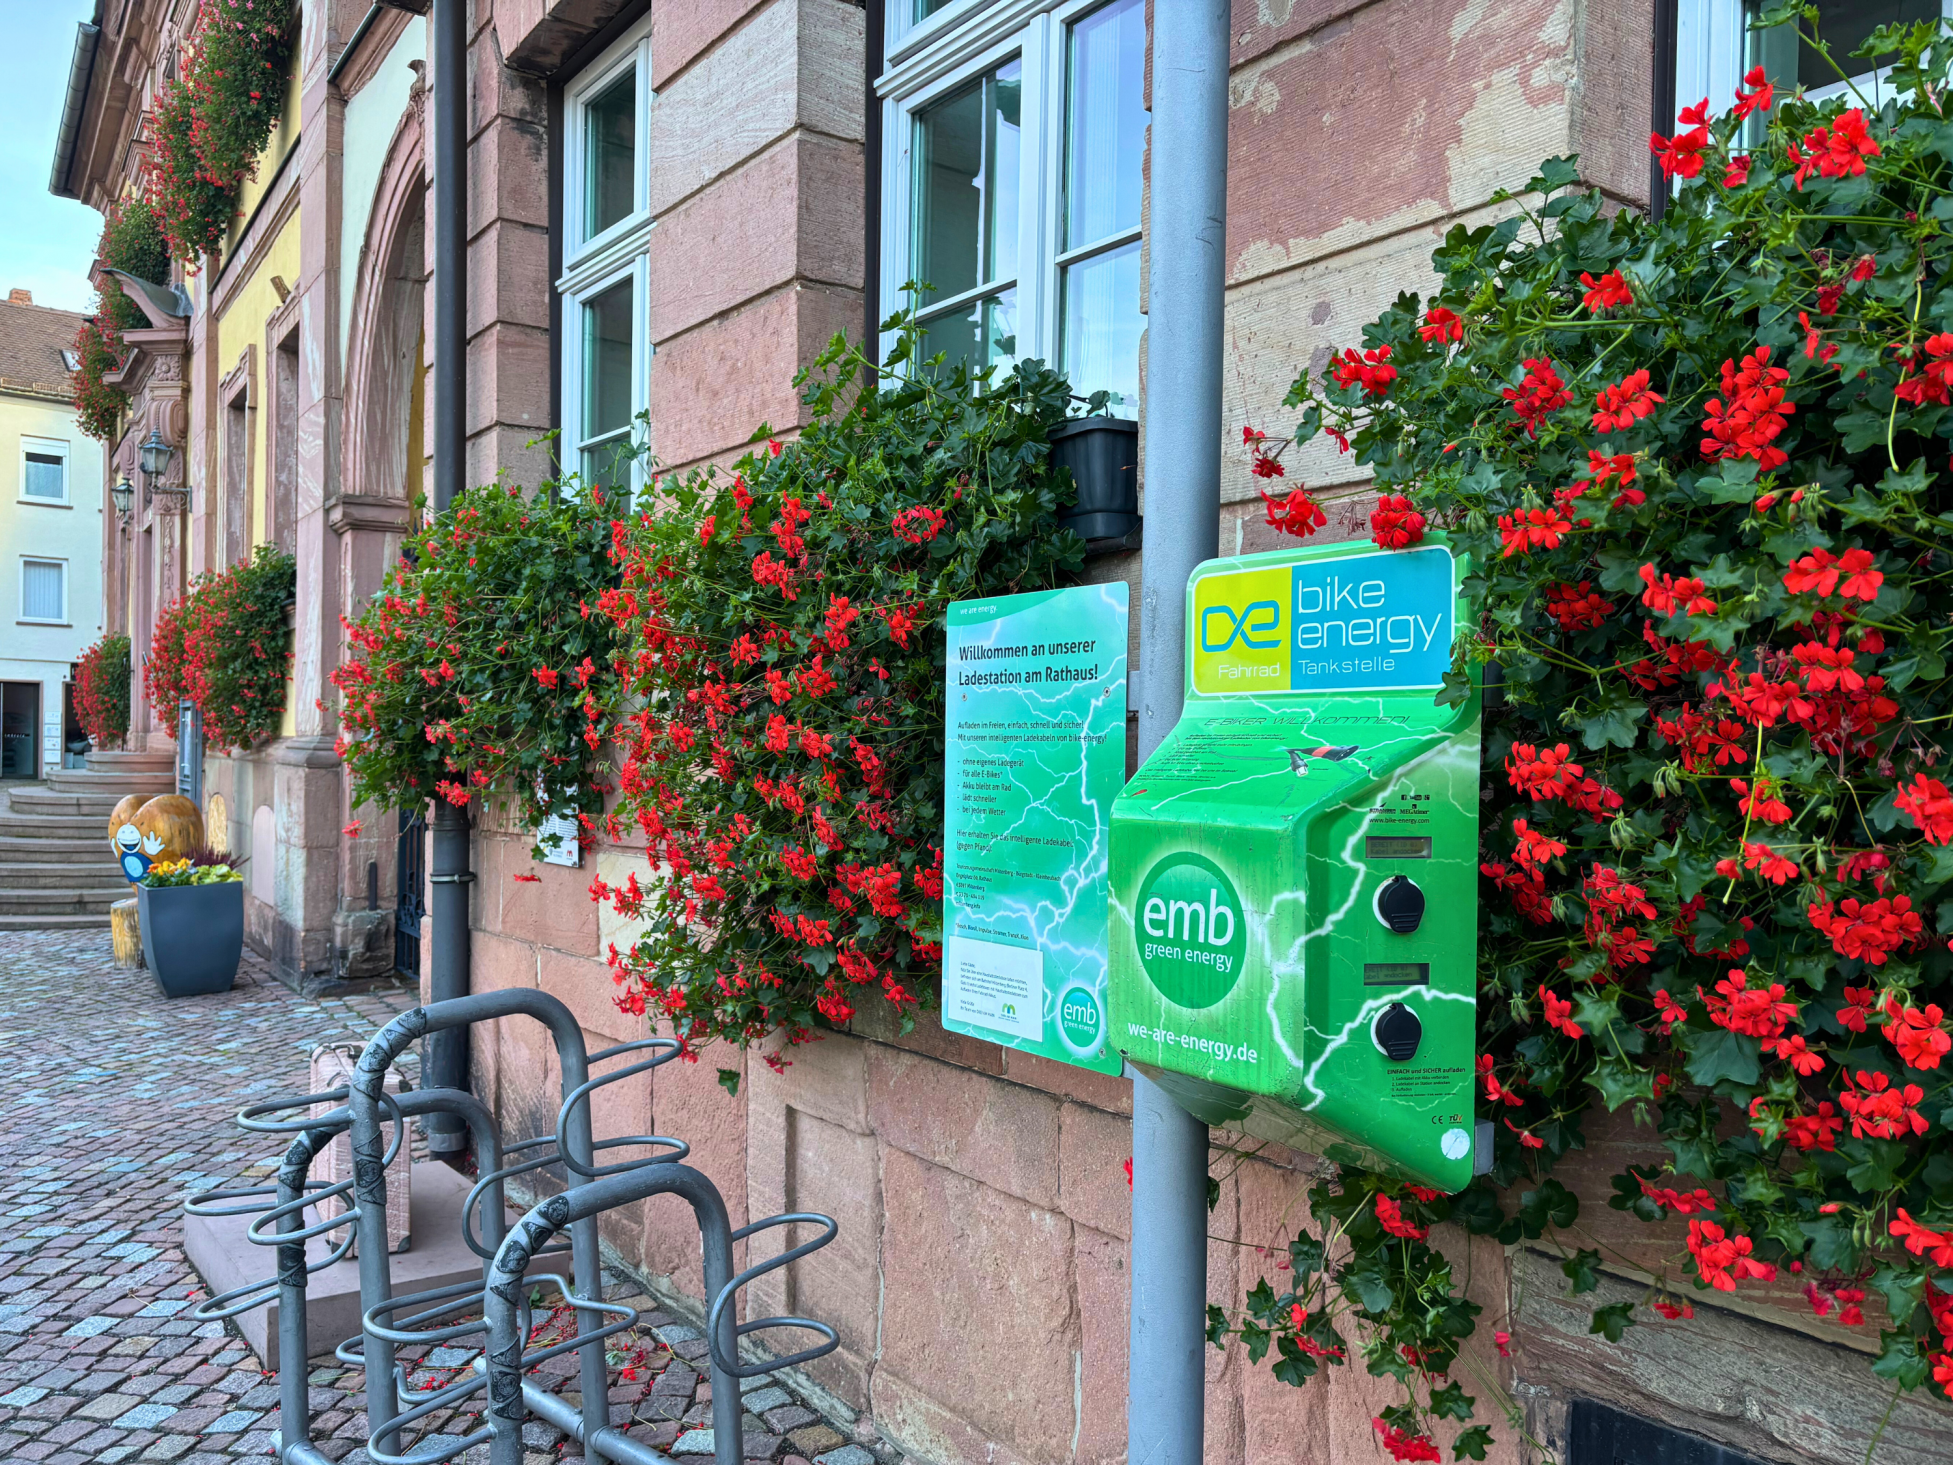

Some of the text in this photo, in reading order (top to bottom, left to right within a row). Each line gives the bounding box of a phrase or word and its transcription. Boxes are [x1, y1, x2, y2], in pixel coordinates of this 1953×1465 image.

[1298, 575, 1386, 614] bike
[1298, 612, 1443, 654] energy
[959, 640, 1096, 661] Willkommen an unserer
[1218, 662, 1280, 679] Fahrrad
[1298, 656, 1396, 675] Tankstelle
[958, 664, 1098, 686] Ladestation am Rathaus!
[988, 722, 1007, 730] Freien,
[1008, 721, 1029, 730] einfach,
[1030, 721, 1050, 729] schnell
[1051, 721, 1063, 729] und
[1064, 720, 1084, 729] sicher!
[1204, 717, 1267, 726] E-BIKER
[988, 734, 1022, 743] intelligenten
[1023, 734, 1056, 742] Ladekabeln
[997, 759, 1024, 768] Ladegerät
[975, 782, 991, 791] bleibt
[1001, 783, 1012, 792] Rad
[973, 794, 996, 803] schneller
[971, 807, 987, 815] jedem
[988, 807, 1006, 816] Wetter
[956, 829, 967, 837] Hier
[968, 831, 990, 840] erhalten
[990, 832, 999, 840] Sie
[1000, 833, 1009, 841] das
[1010, 834, 1042, 845] intelligente
[1143, 888, 1235, 946] emb
[1144, 942, 1233, 973] green energy
[1064, 1002, 1096, 1024] emb
[1079, 1024, 1095, 1035] energy
[1128, 1022, 1258, 1063] we-are-energy.de
